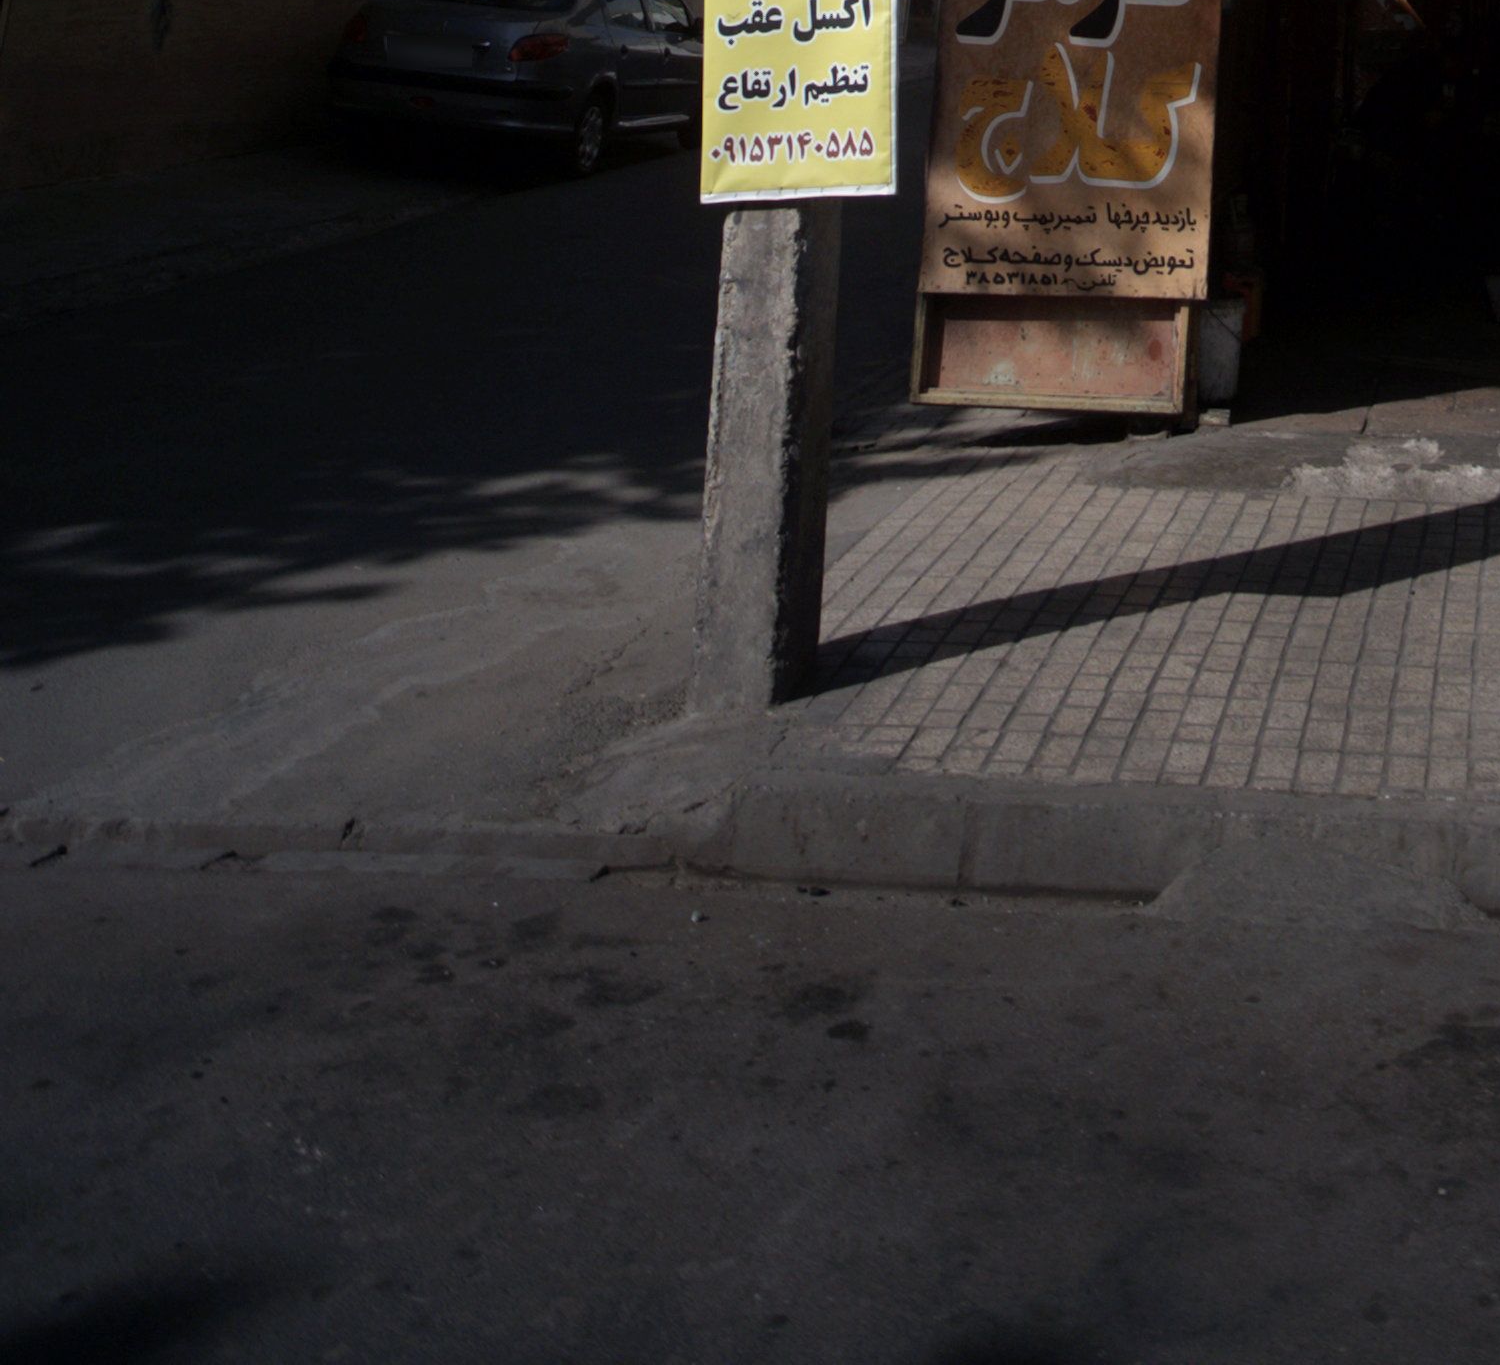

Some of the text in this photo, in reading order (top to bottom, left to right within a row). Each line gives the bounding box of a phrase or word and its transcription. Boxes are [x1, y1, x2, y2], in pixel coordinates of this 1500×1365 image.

[718, 1, 782, 46] عقب
[719, 65, 868, 109] تنظیم ارتفاع
[955, 42, 1201, 204] کلاج
[711, 130, 874, 163] ۰۹۱۵۳۱۴۰۵۸۵
